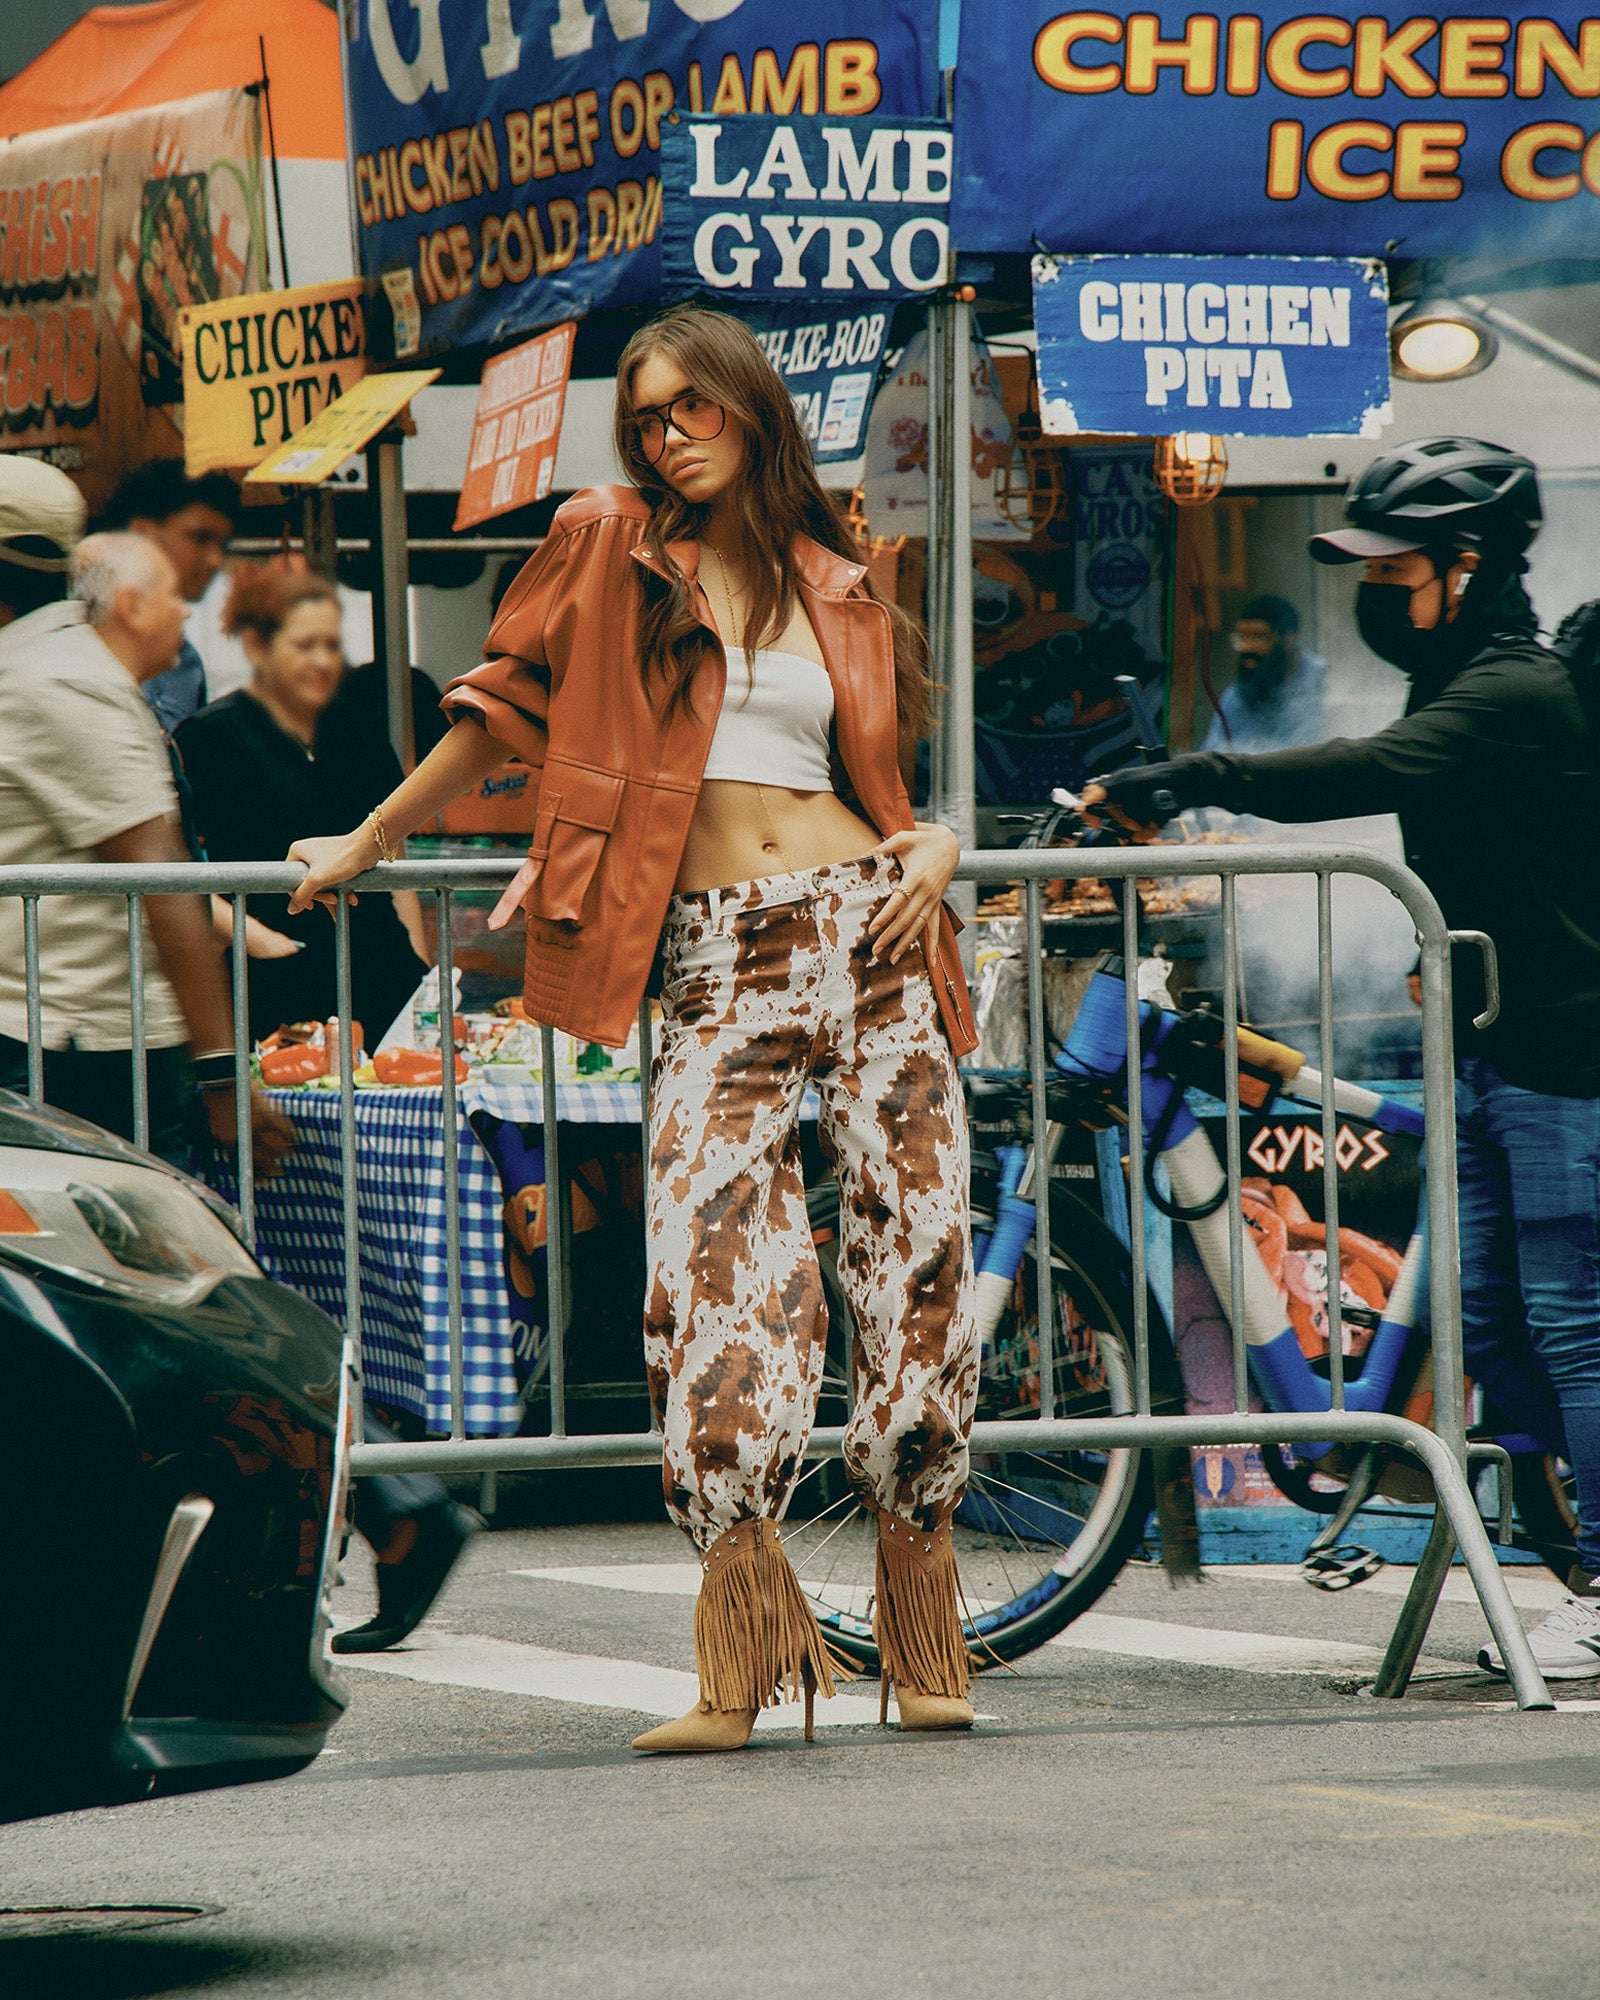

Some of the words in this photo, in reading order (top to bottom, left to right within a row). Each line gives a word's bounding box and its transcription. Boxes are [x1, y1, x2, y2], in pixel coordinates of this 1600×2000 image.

[1034, 11, 1600, 98] CHICKEN
[356, 118, 499, 228] CHICKEN
[505, 90, 601, 185] BEEF
[688, 124, 954, 203] LAMB
[1265, 119, 1467, 201] ICE
[1501, 119, 1600, 202] C
[418, 224, 474, 305] ICE
[480, 198, 579, 289] COLD
[693, 212, 950, 292] GYRO
[250, 372, 343, 447] PITA
[1144, 346, 1293, 409] PITA
[1247, 1124, 1390, 1173] GYROS
